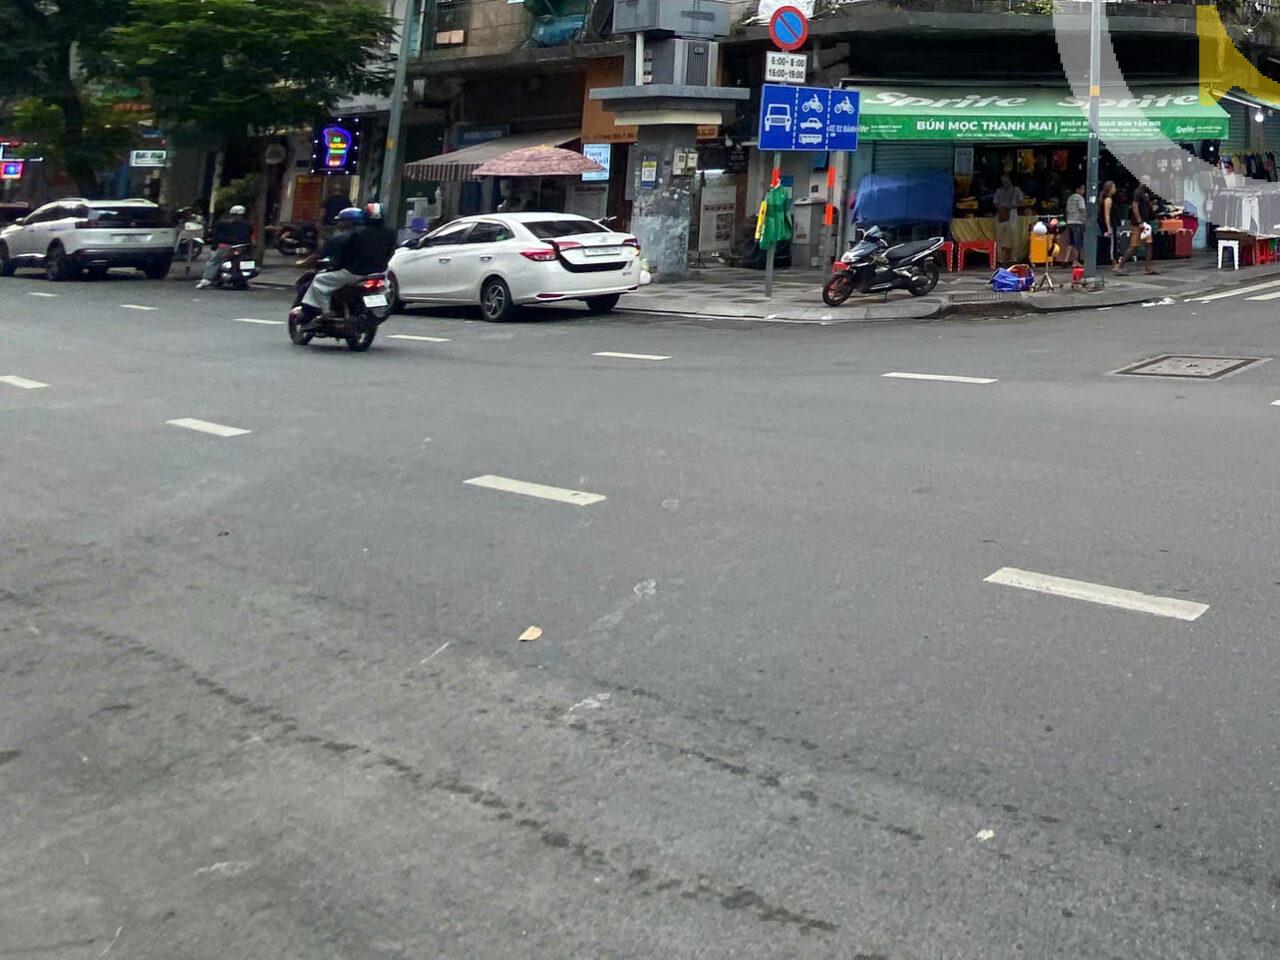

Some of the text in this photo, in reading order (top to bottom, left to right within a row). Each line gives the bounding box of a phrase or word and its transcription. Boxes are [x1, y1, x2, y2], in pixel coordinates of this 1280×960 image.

[864, 92, 1027, 109] Sprite
[916, 119, 945, 131] BÚN
[948, 120, 978, 133] MỌC
[981, 121, 1025, 131] THANH
[1029, 121, 1052, 131] MAI
